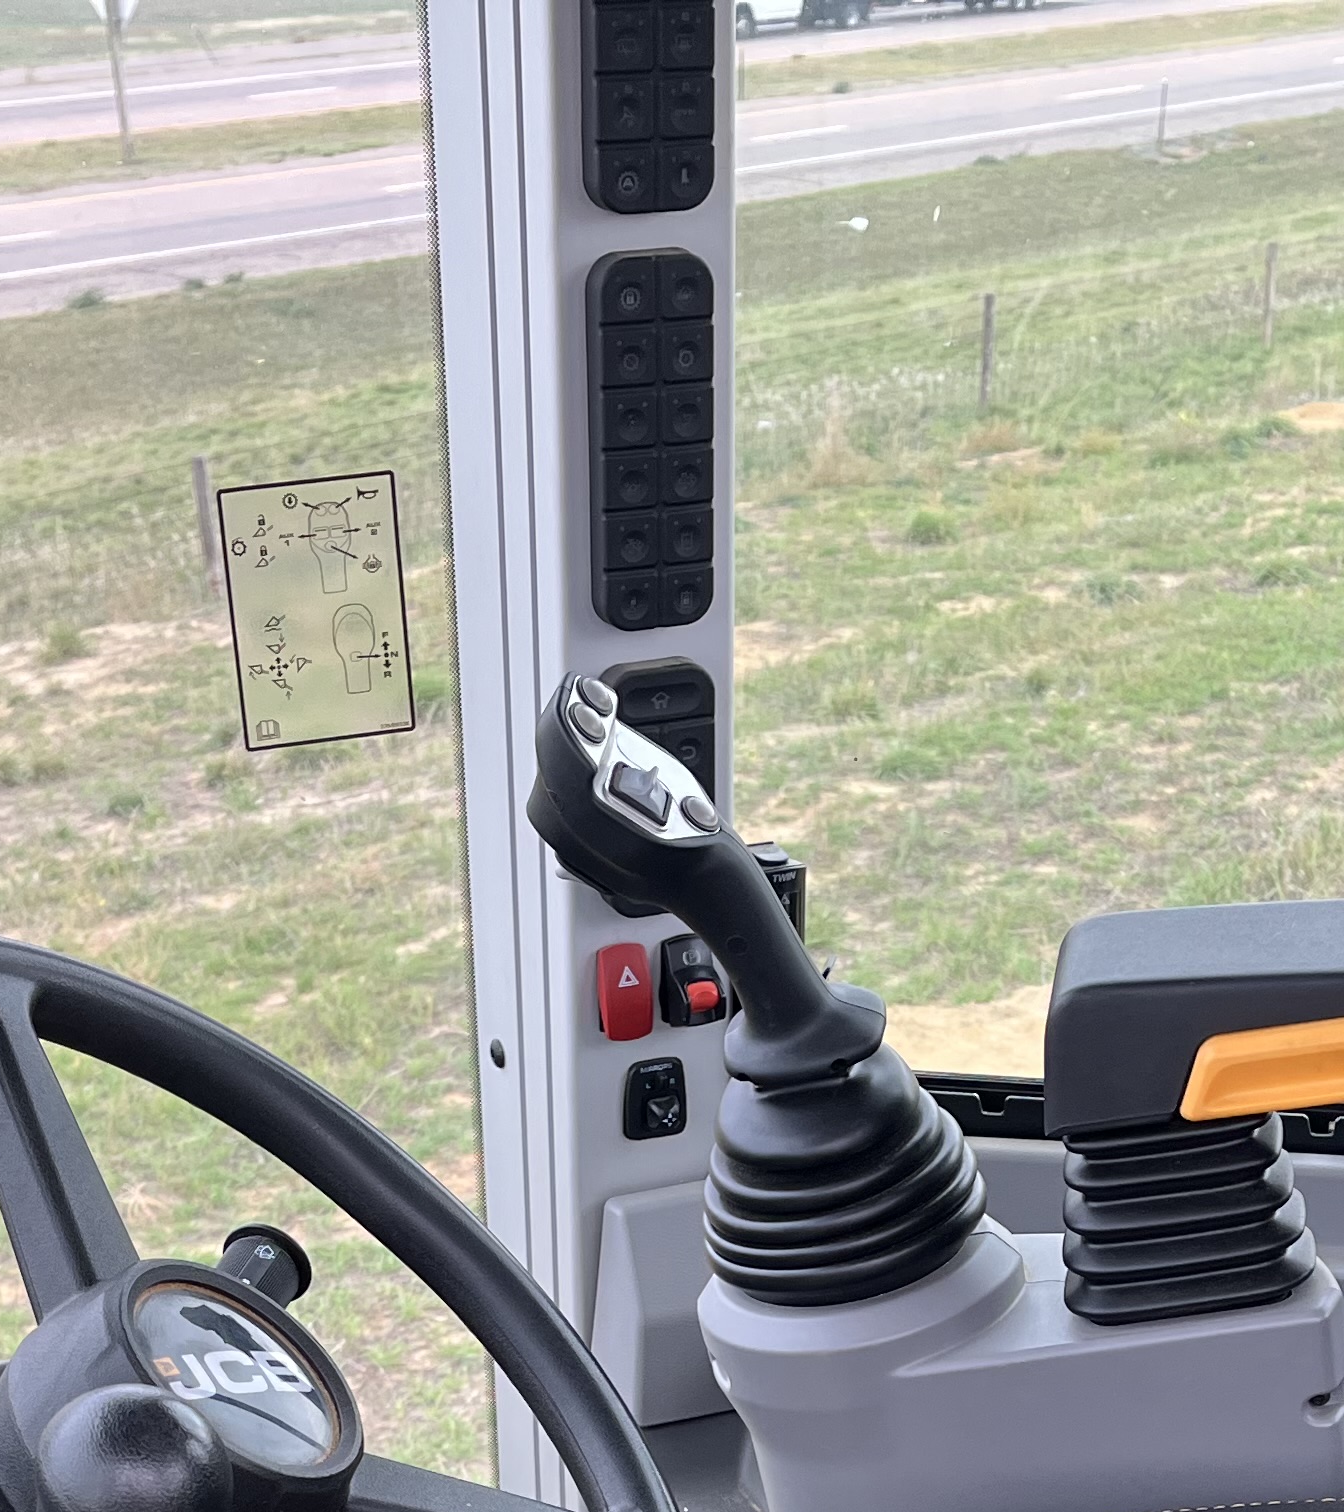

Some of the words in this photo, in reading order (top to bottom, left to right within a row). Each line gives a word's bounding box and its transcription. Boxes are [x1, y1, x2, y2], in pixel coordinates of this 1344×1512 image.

[390, 650, 399, 658] N
[772, 870, 797, 883] TWIN
[169, 1350, 316, 1400] JCB
